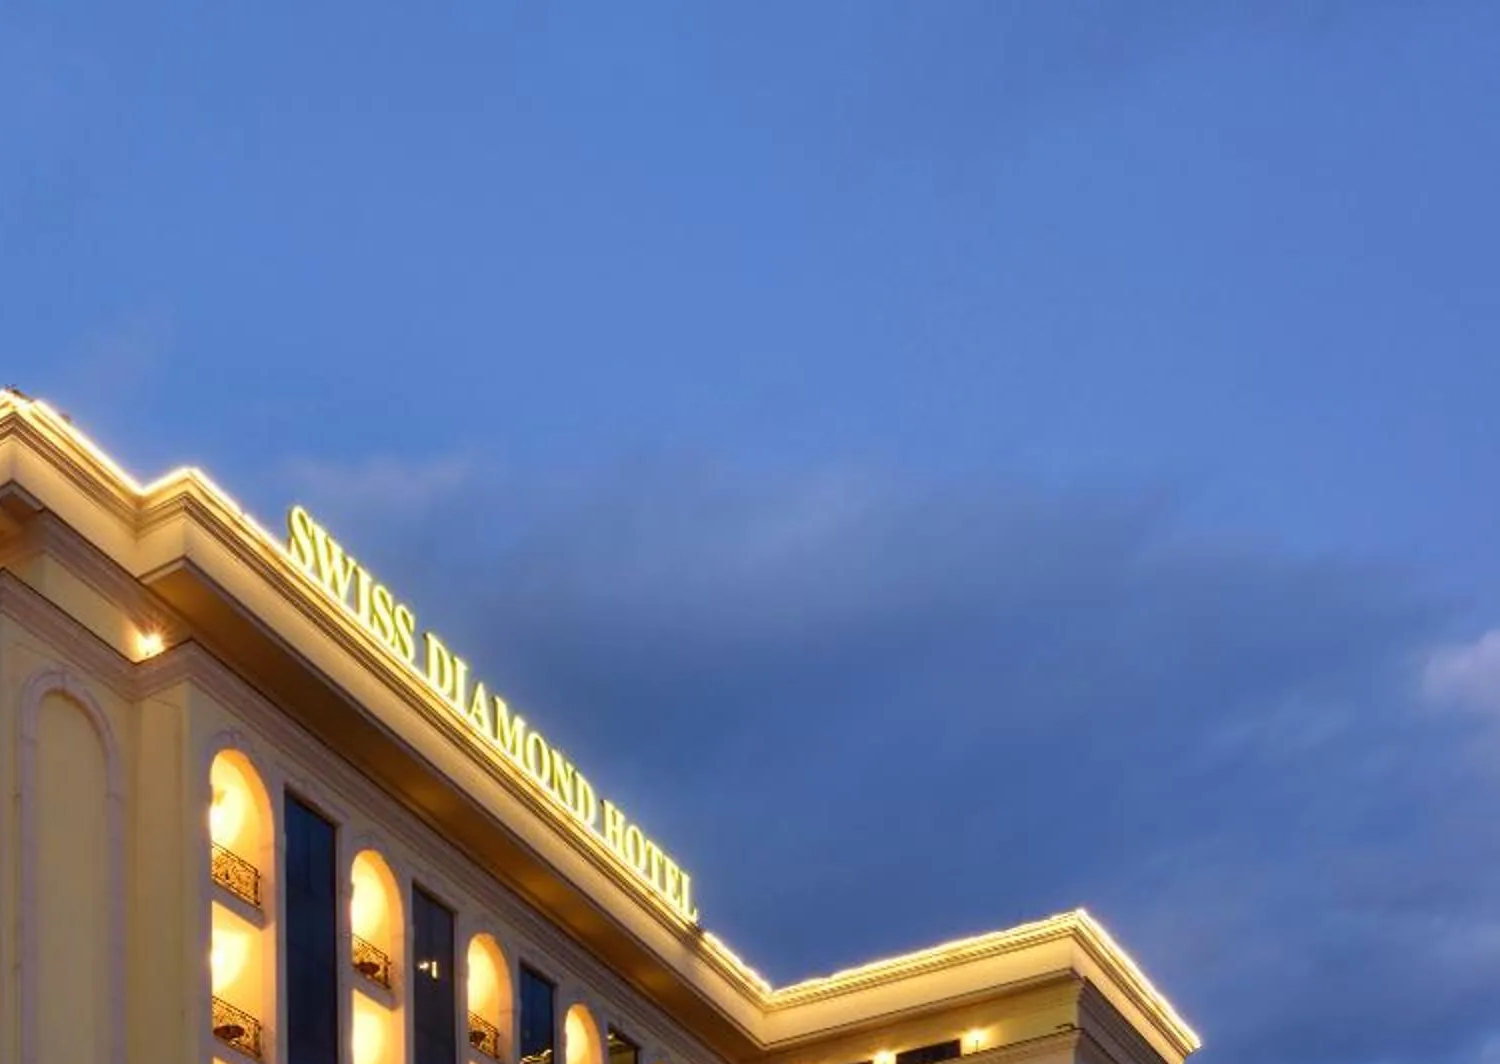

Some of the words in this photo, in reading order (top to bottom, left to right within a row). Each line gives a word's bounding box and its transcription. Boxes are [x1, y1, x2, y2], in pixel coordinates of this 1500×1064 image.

[288, 504, 415, 668] SWISS
[423, 631, 596, 828] DIAMOND
[601, 798, 697, 925] HOTEL
